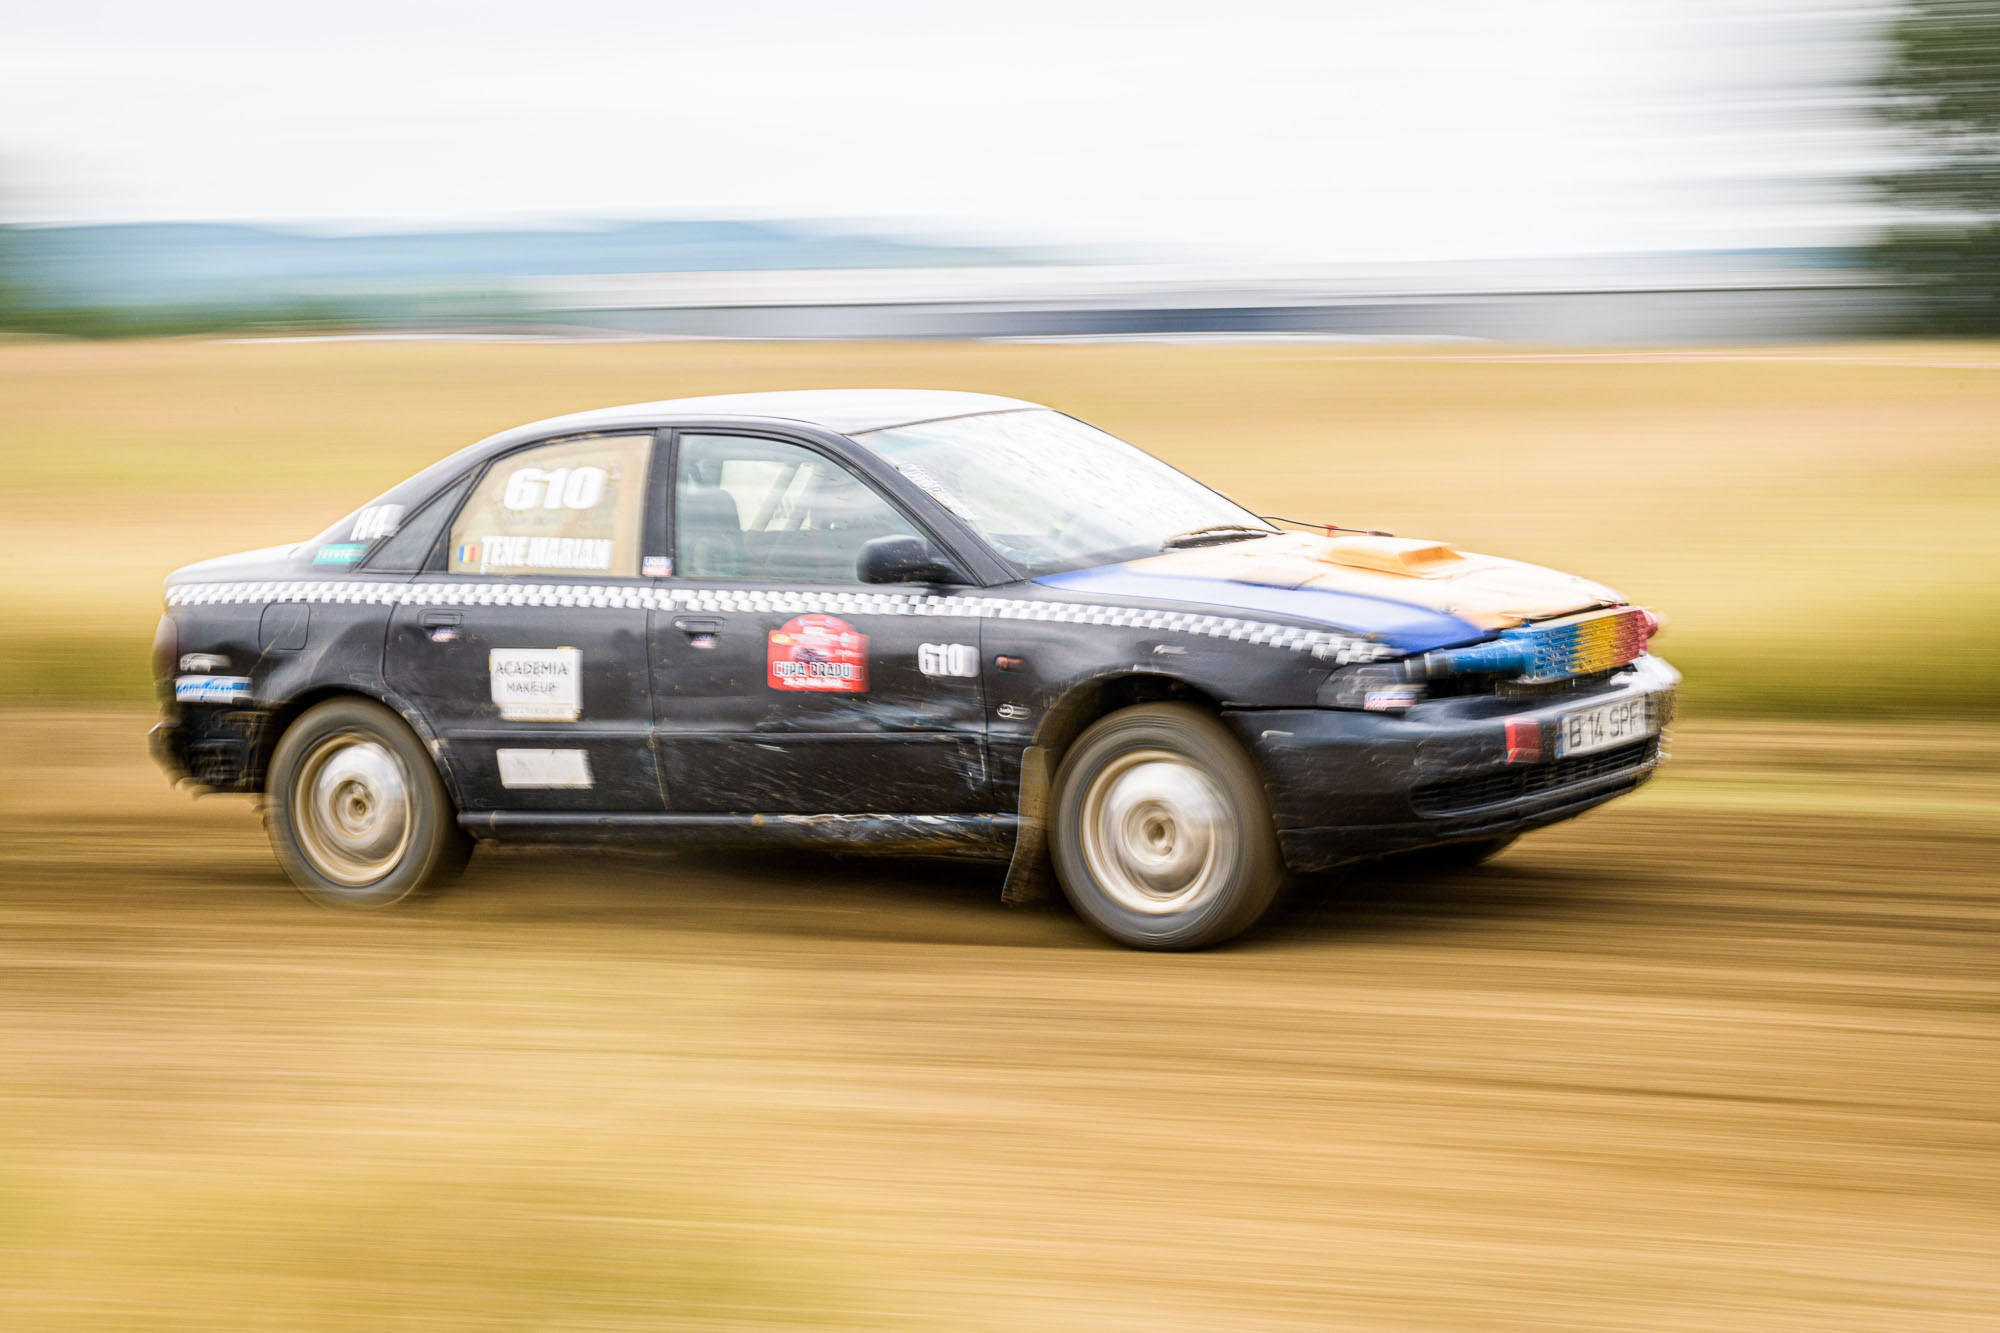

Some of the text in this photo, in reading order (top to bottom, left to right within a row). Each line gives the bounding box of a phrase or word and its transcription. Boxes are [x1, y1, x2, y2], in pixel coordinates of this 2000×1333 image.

[503, 466, 609, 510] 610
[494, 661, 569, 676] ACADEMIA
[773, 661, 806, 678] CUPA
[918, 643, 976, 677] 610
[1569, 701, 1639, 748] B 14 SPF
